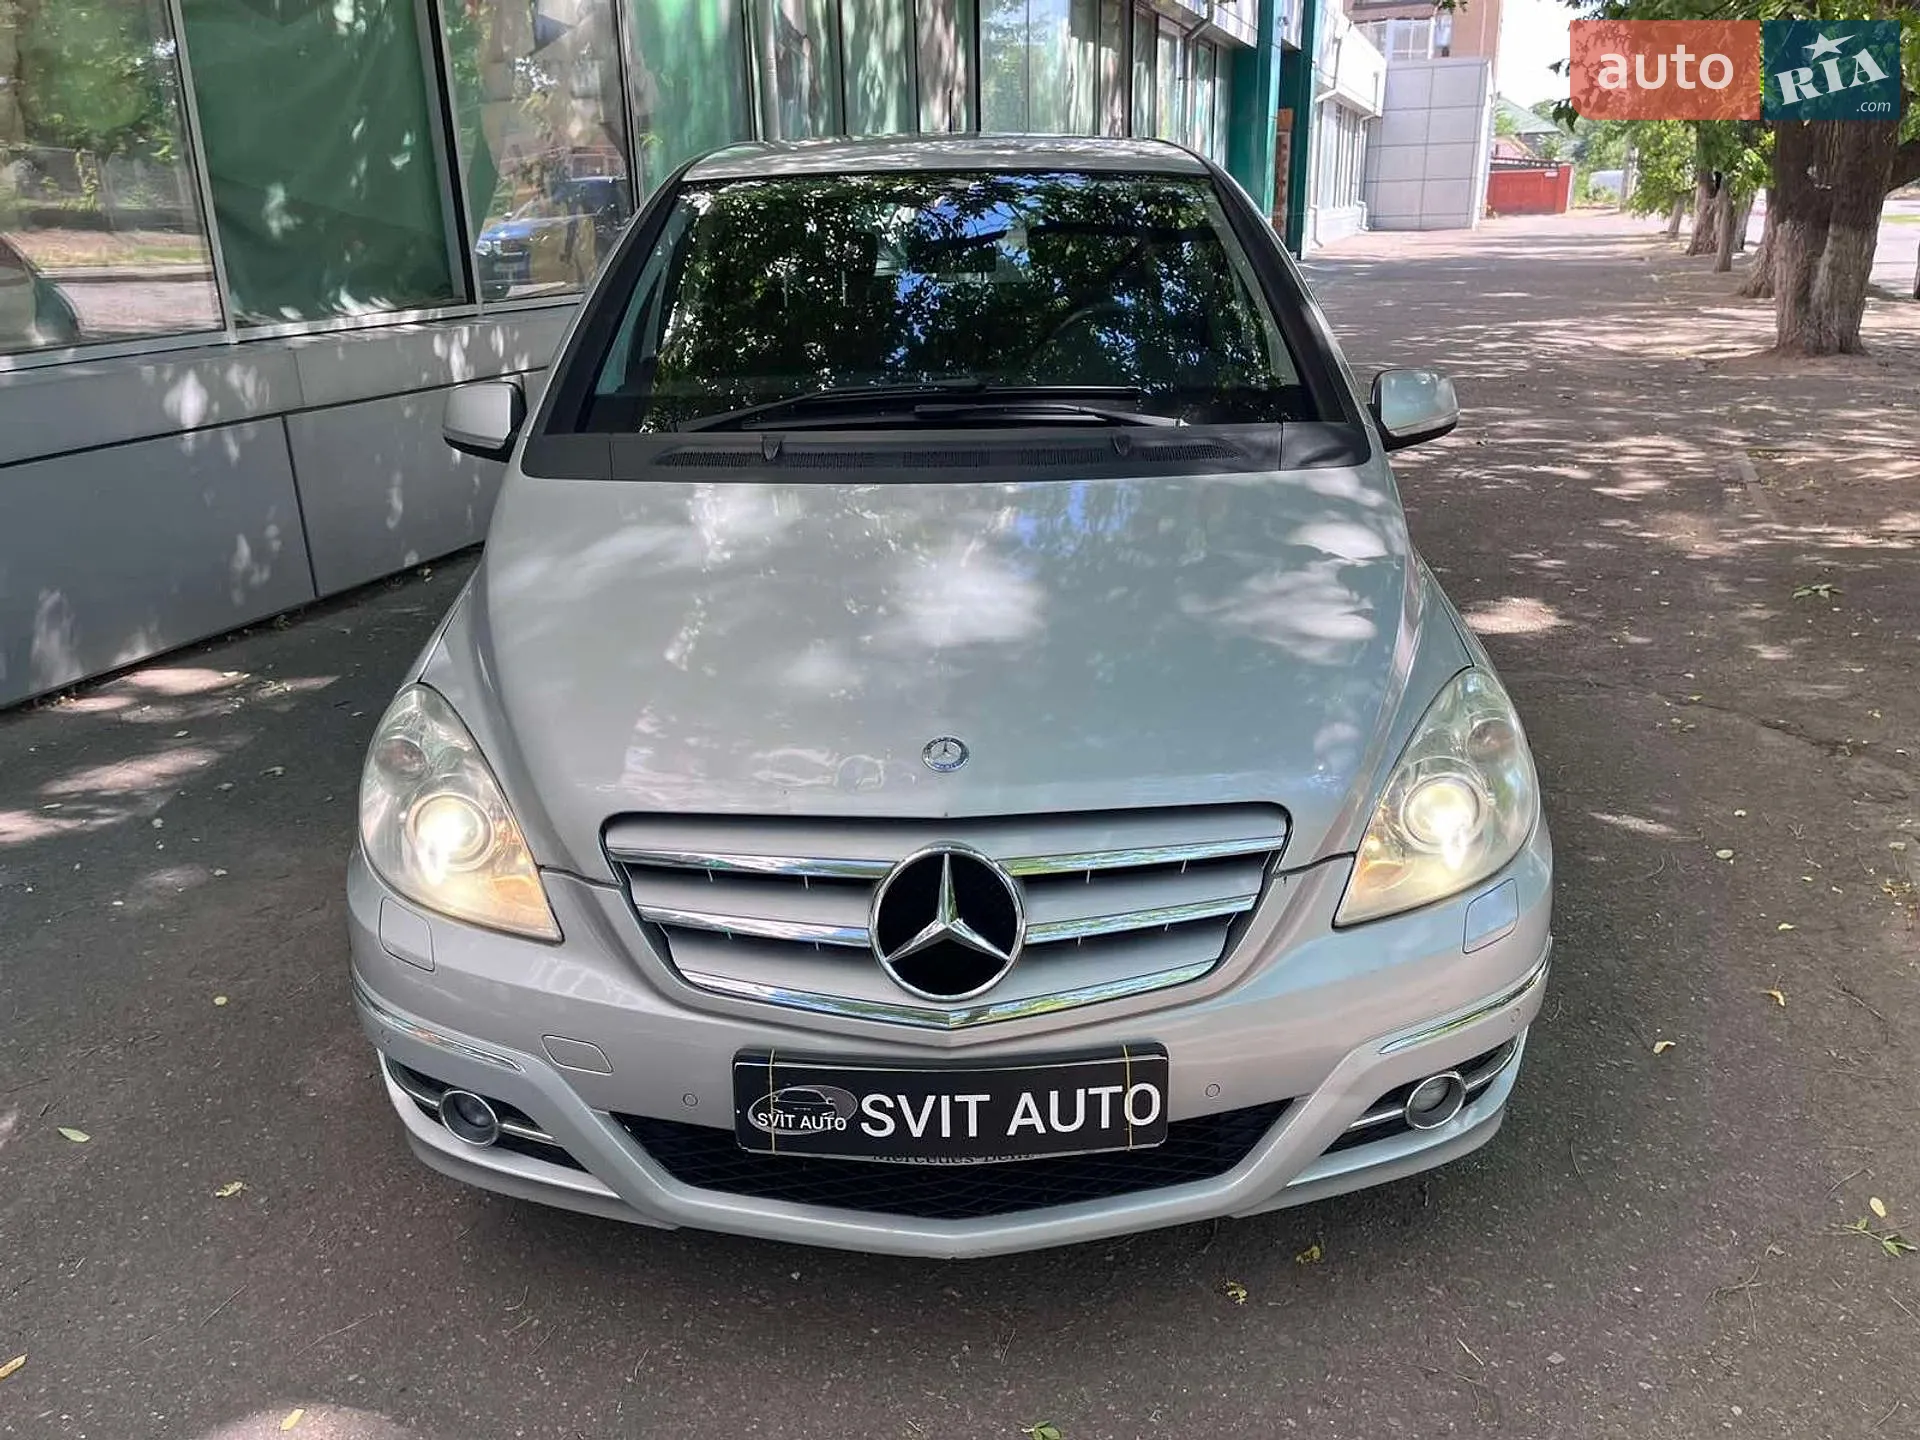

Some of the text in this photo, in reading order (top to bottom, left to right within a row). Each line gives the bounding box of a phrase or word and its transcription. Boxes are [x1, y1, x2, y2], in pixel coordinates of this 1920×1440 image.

[757, 1112, 847, 1131] SVIT AUTO
[861, 1082, 1161, 1139] SVIT AUTO
